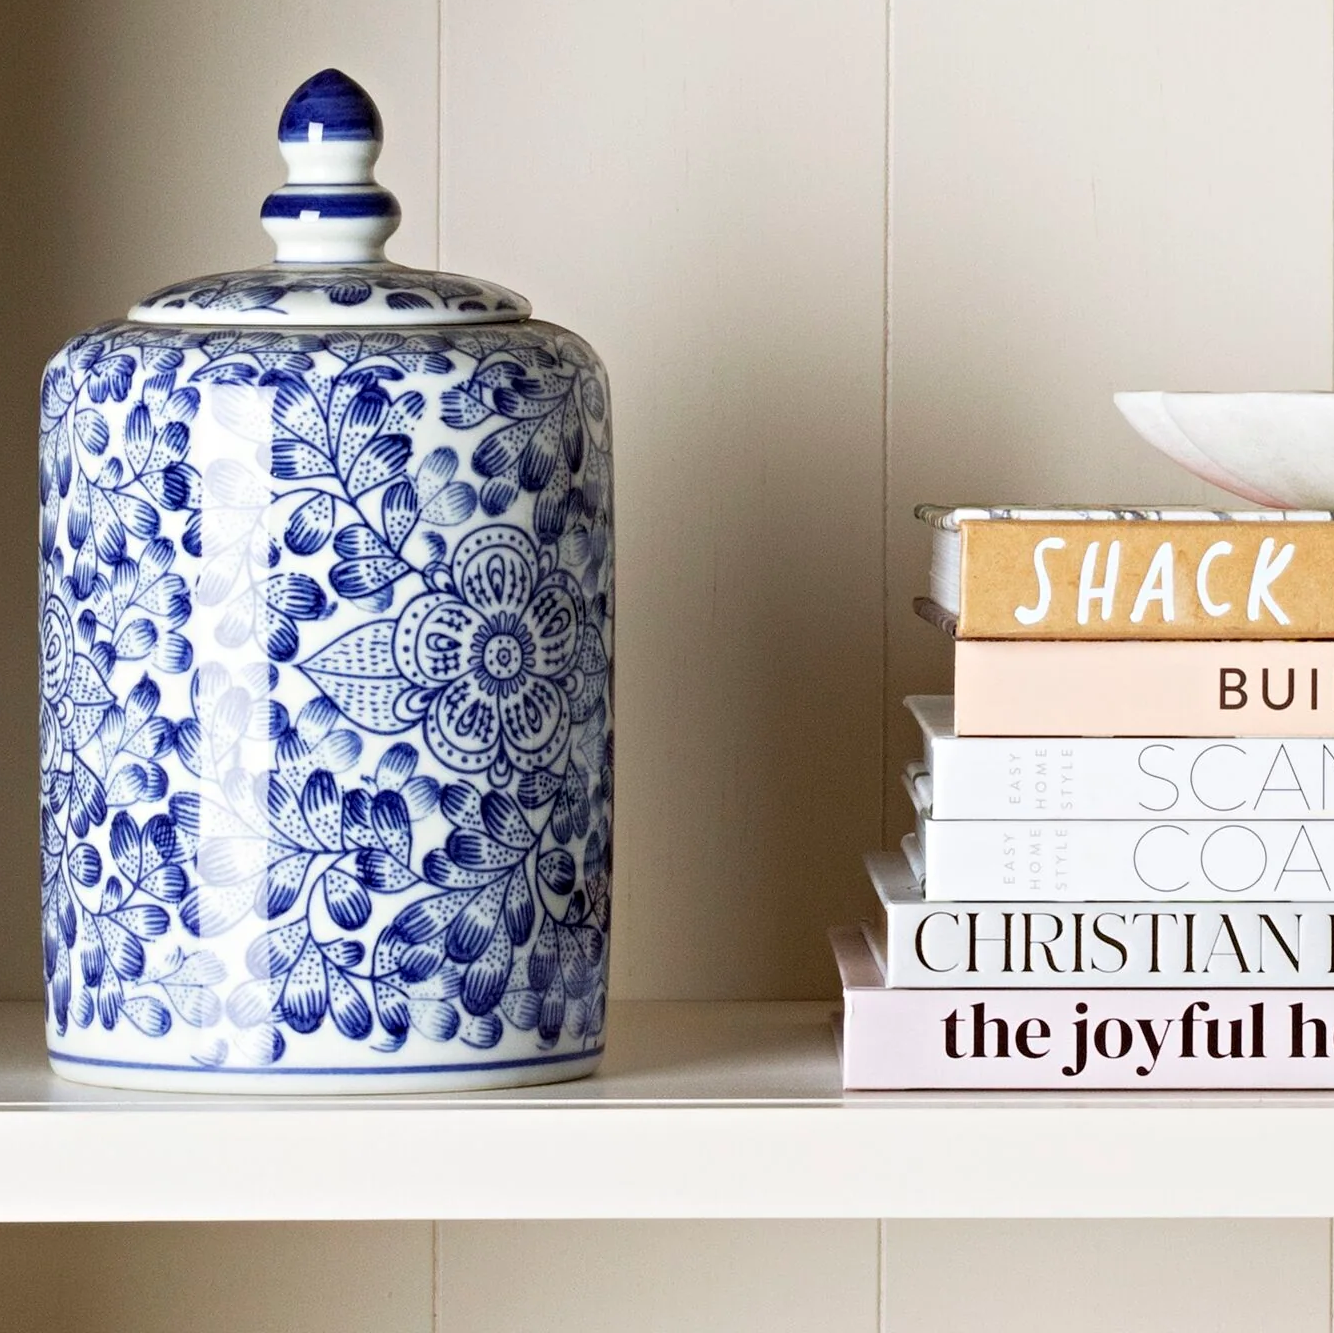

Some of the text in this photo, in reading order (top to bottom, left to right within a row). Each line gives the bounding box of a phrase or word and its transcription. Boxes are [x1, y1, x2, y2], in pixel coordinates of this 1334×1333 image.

[1014, 536, 1296, 625] SHACK
[1009, 753, 1021, 805] EASY
[1035, 748, 1047, 810] HOME
[1061, 749, 1073, 810] STYLE
[1003, 833, 1016, 885] EASY
[1029, 829, 1042, 890] HOME
[1055, 829, 1068, 891] STYLE
[914, 911, 1304, 974] CHRISTIAN
[940, 1001, 1052, 1059] the
[1061, 1000, 1269, 1078] joyful
